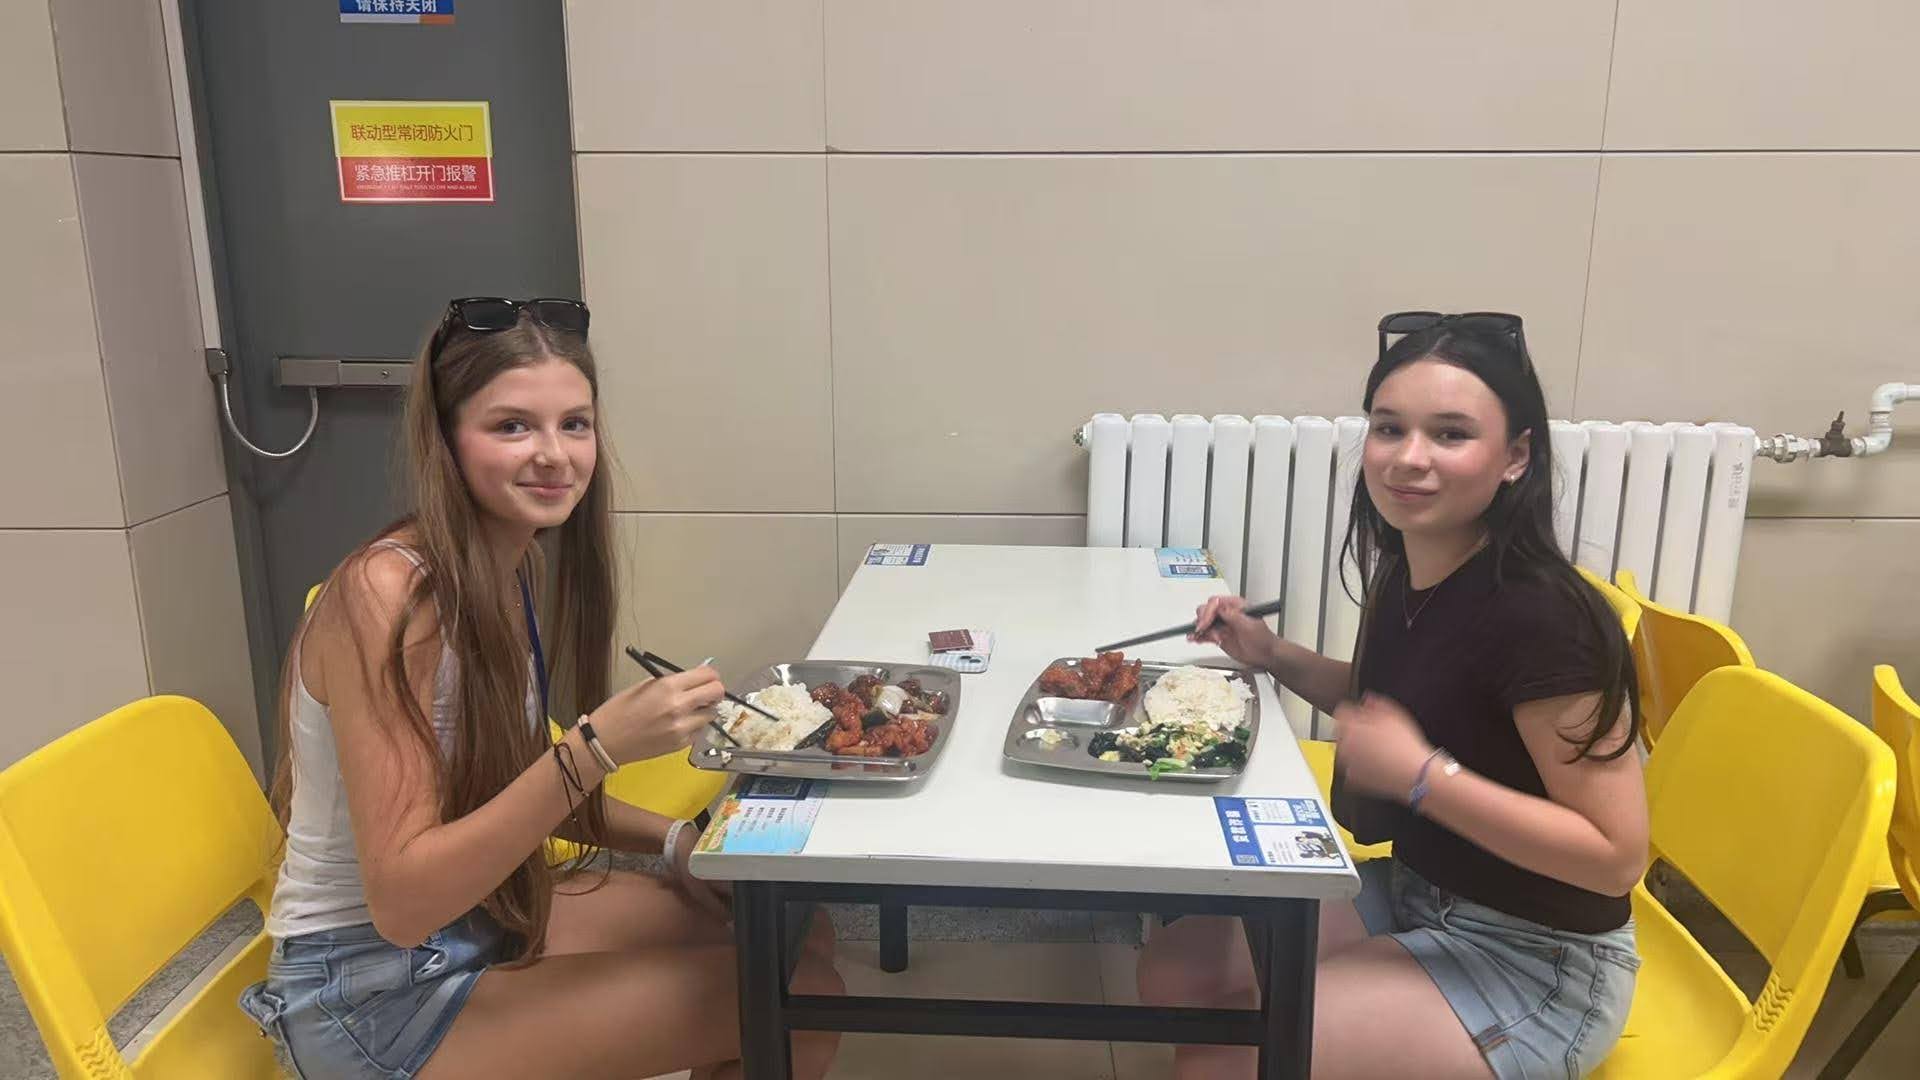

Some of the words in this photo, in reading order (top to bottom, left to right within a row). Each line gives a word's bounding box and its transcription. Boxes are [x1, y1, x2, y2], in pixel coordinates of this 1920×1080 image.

[356, 0, 437, 12] 请保持关闭
[351, 124, 474, 142] 联动型常闭防火门
[354, 164, 477, 182] 紧急推杠开门报警
